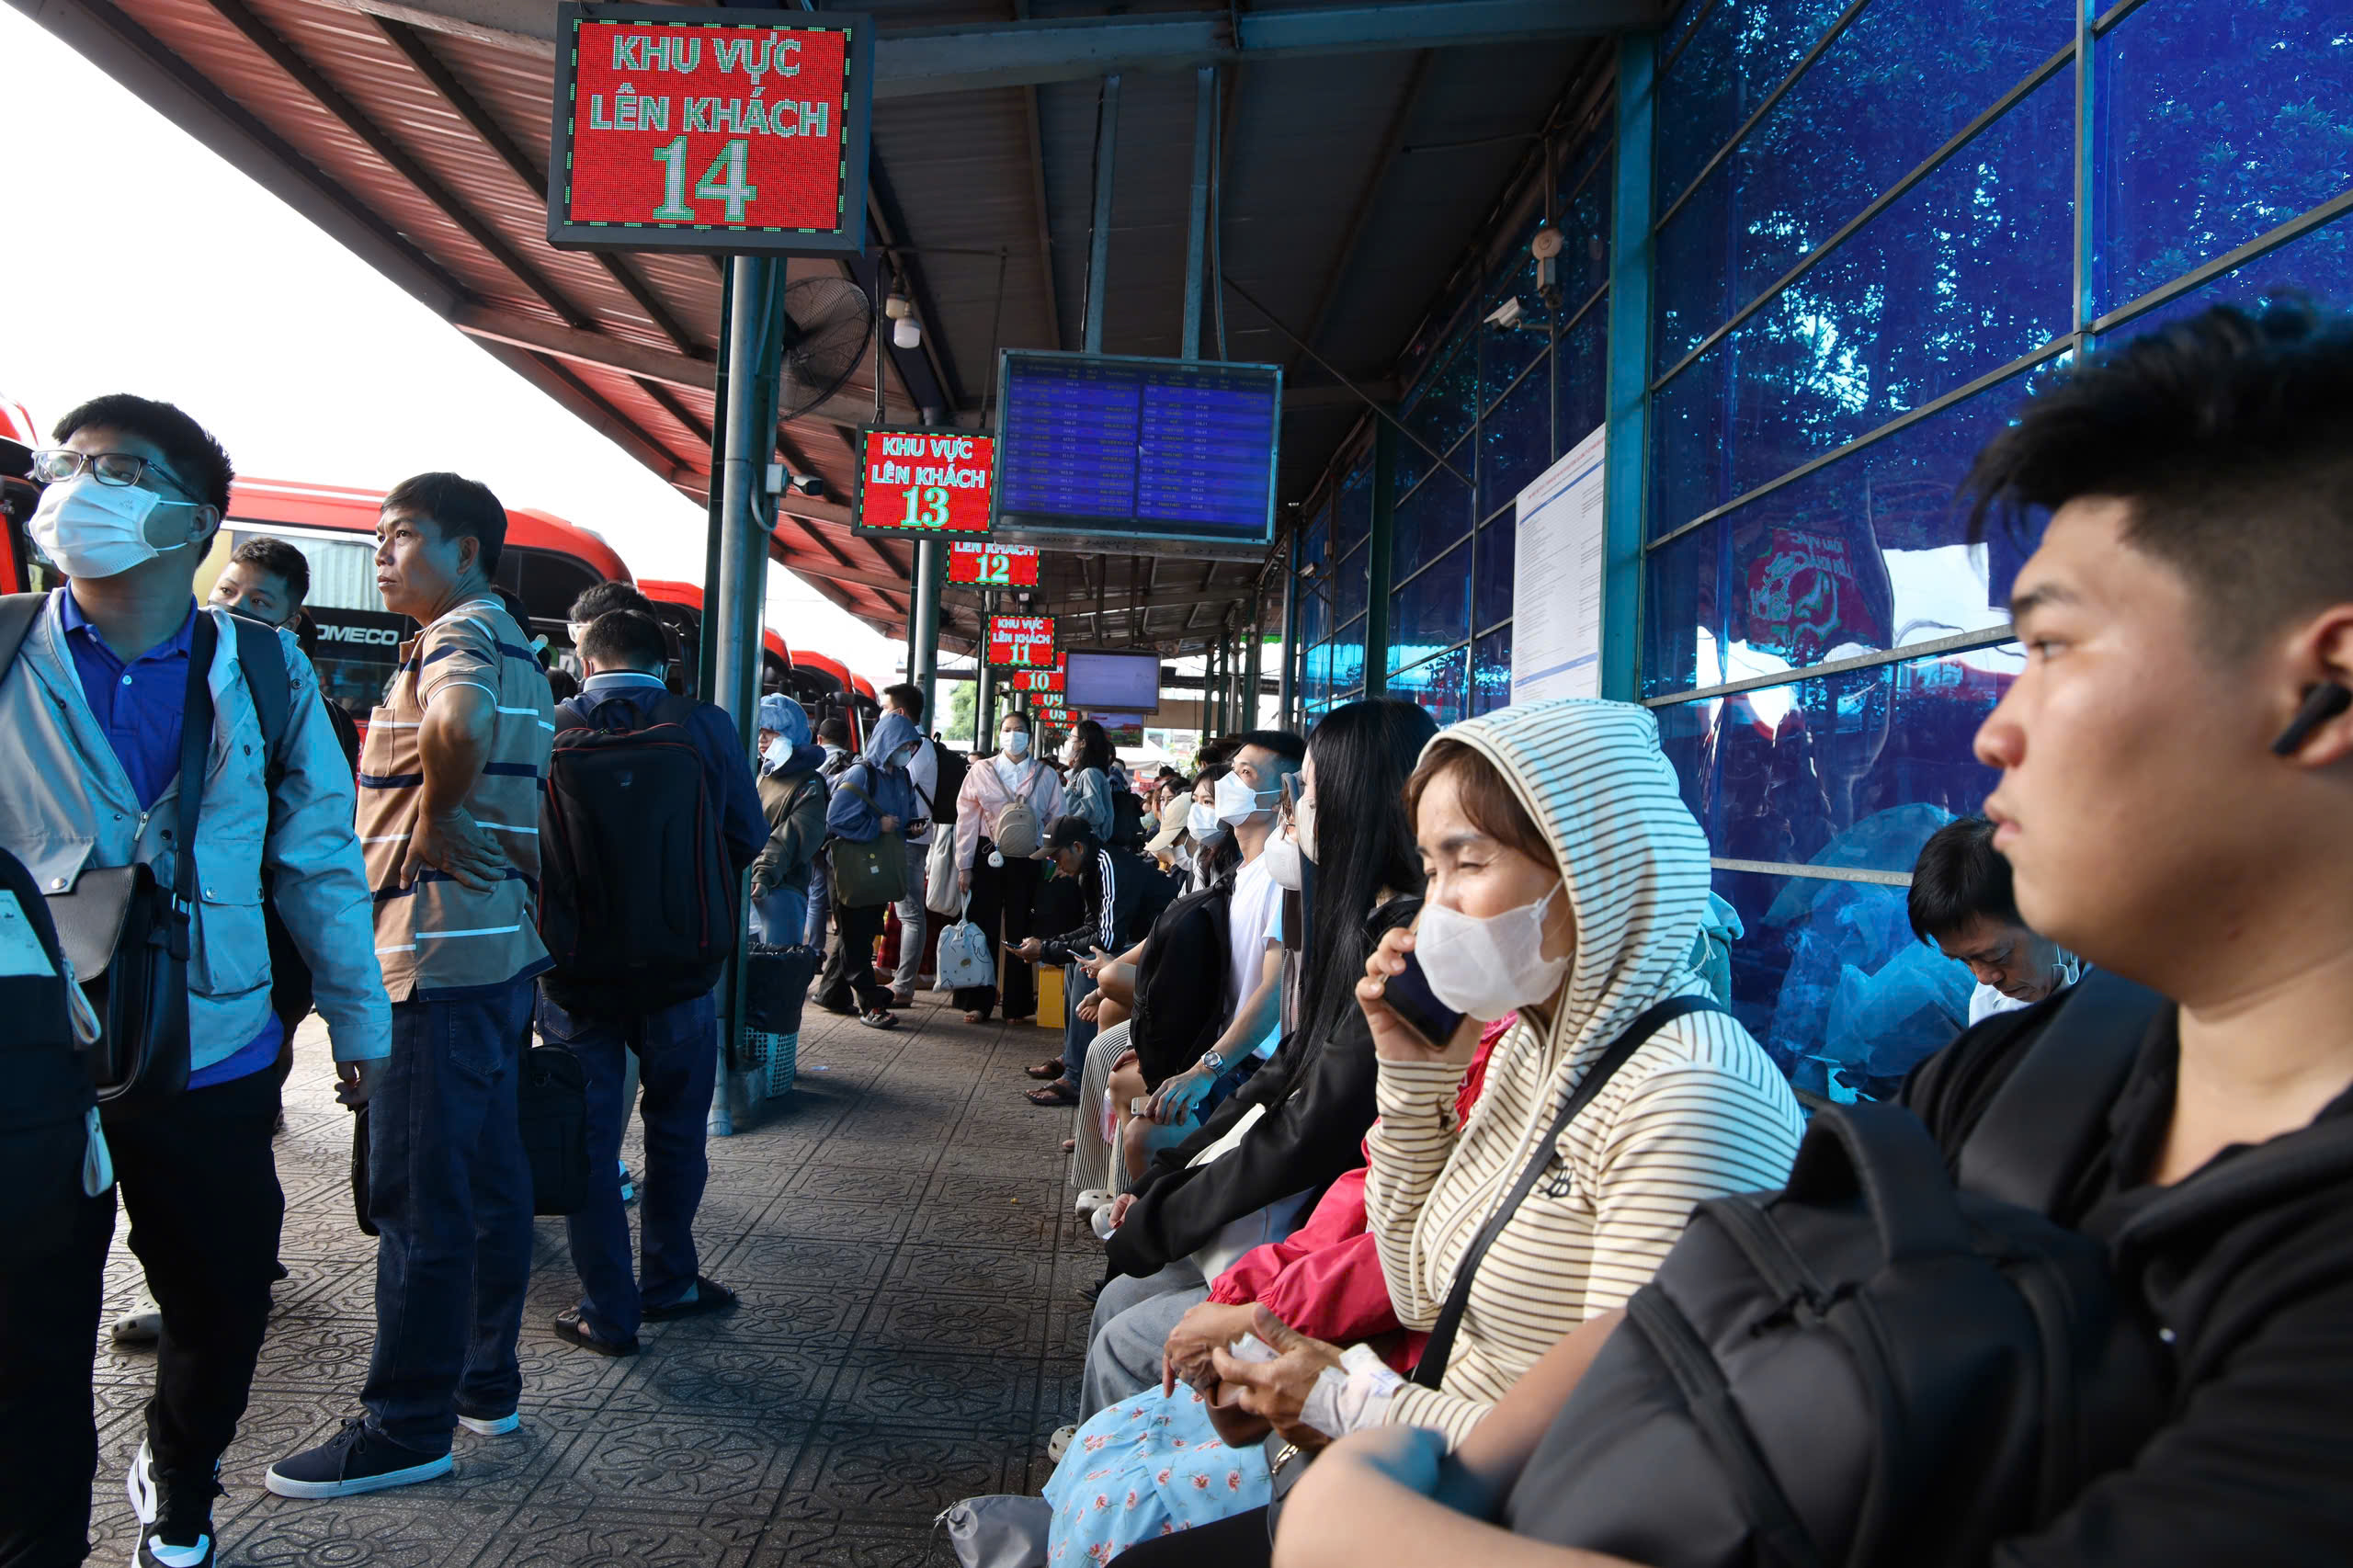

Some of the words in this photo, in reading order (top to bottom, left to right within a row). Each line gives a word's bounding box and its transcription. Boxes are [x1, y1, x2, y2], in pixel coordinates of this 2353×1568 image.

[612, 34, 701, 74] KHU
[711, 31, 801, 85] VỰC
[590, 82, 669, 131] LÊN
[683, 85, 829, 138] KHÁCH
[652, 135, 757, 222] 14
[882, 437, 925, 457] KHU
[931, 437, 973, 462] VỰC
[871, 460, 910, 484] LÊN
[915, 463, 986, 489] KHÁCH
[901, 485, 949, 528] 13
[975, 553, 1010, 584] 12
[316, 624, 399, 646] OMECO
[997, 619, 1020, 630] KHU
[1022, 618, 1044, 631] VỰC
[993, 631, 1013, 643] LÊN
[1015, 631, 1051, 644] KHÁCH
[1009, 643, 1032, 665] 11
[1029, 672, 1050, 691] 10
[1043, 694, 1063, 708] 09
